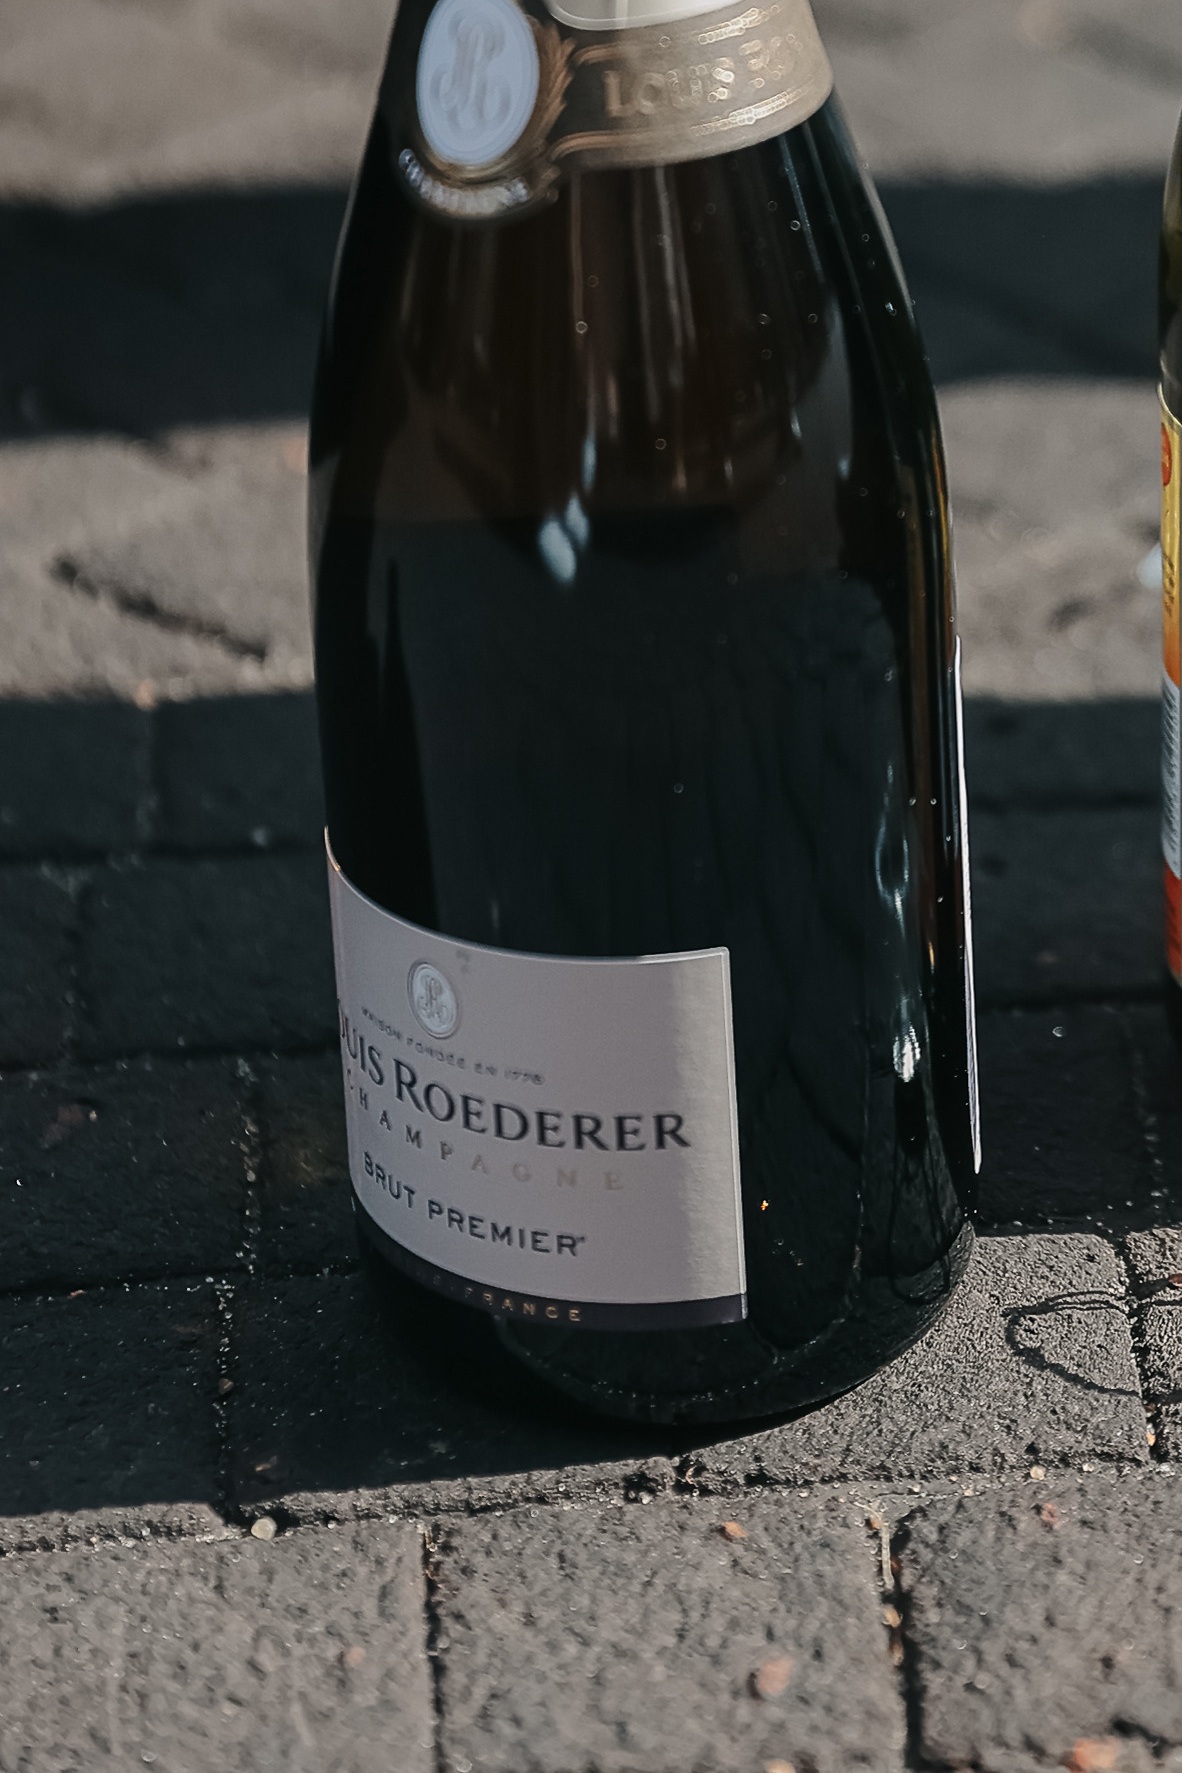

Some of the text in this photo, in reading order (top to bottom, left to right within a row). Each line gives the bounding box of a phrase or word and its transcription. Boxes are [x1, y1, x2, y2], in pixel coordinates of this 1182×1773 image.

[346, 1068, 625, 1193] CHAMPAGNE
[393, 1057, 692, 1153] ROEDERER
[363, 1150, 579, 1257] BRUT PREMIER
[463, 1286, 582, 1322] FRANCE
